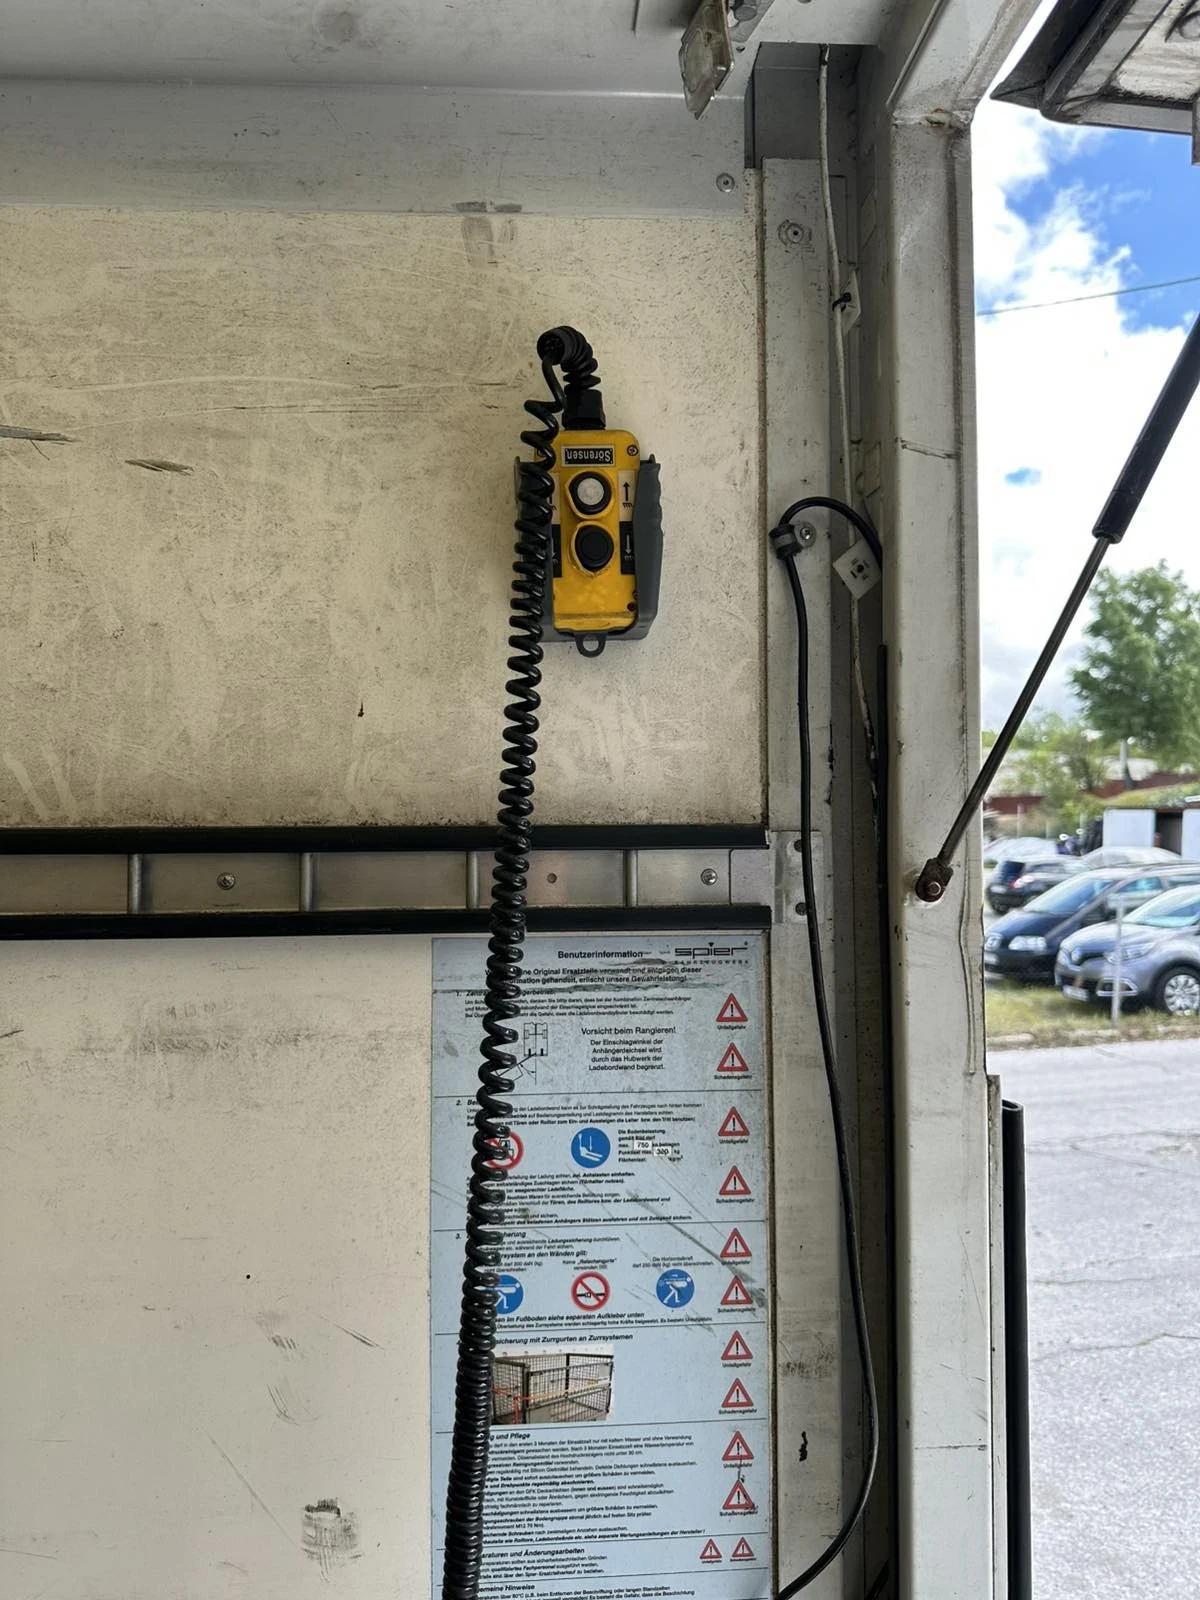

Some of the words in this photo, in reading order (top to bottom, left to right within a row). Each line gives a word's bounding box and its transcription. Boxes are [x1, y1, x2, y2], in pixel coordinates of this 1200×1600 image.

[567, 450, 611, 462] Sörensen
[558, 950, 643, 959] Benutzerinformation
[675, 947, 748, 959] spier
[533, 968, 561, 977] Original
[562, 967, 597, 975] Ersatzteile
[542, 976, 578, 985] gehandelt,
[632, 975, 687, 984] Gewährleistung!
[614, 1027, 633, 1035] beim
[635, 1027, 677, 1036] Rangieren!
[603, 1038, 652, 1047] Einschlagwinkel
[592, 1047, 647, 1055] Anhängerdeichsel
[636, 1063, 665, 1072] begrenzt.
[637, 1141, 650, 1149] 750
[576, 1250, 588, 1258] gilt:
[566, 1314, 596, 1322] separaten
[542, 1335, 578, 1344] Zurrgurten
[588, 1333, 634, 1342] Zurrsystemen
[510, 1432, 531, 1441] Pflege
[523, 1546, 585, 1558] Änderungsarbeiten
[504, 1583, 536, 1591] Hinweise
